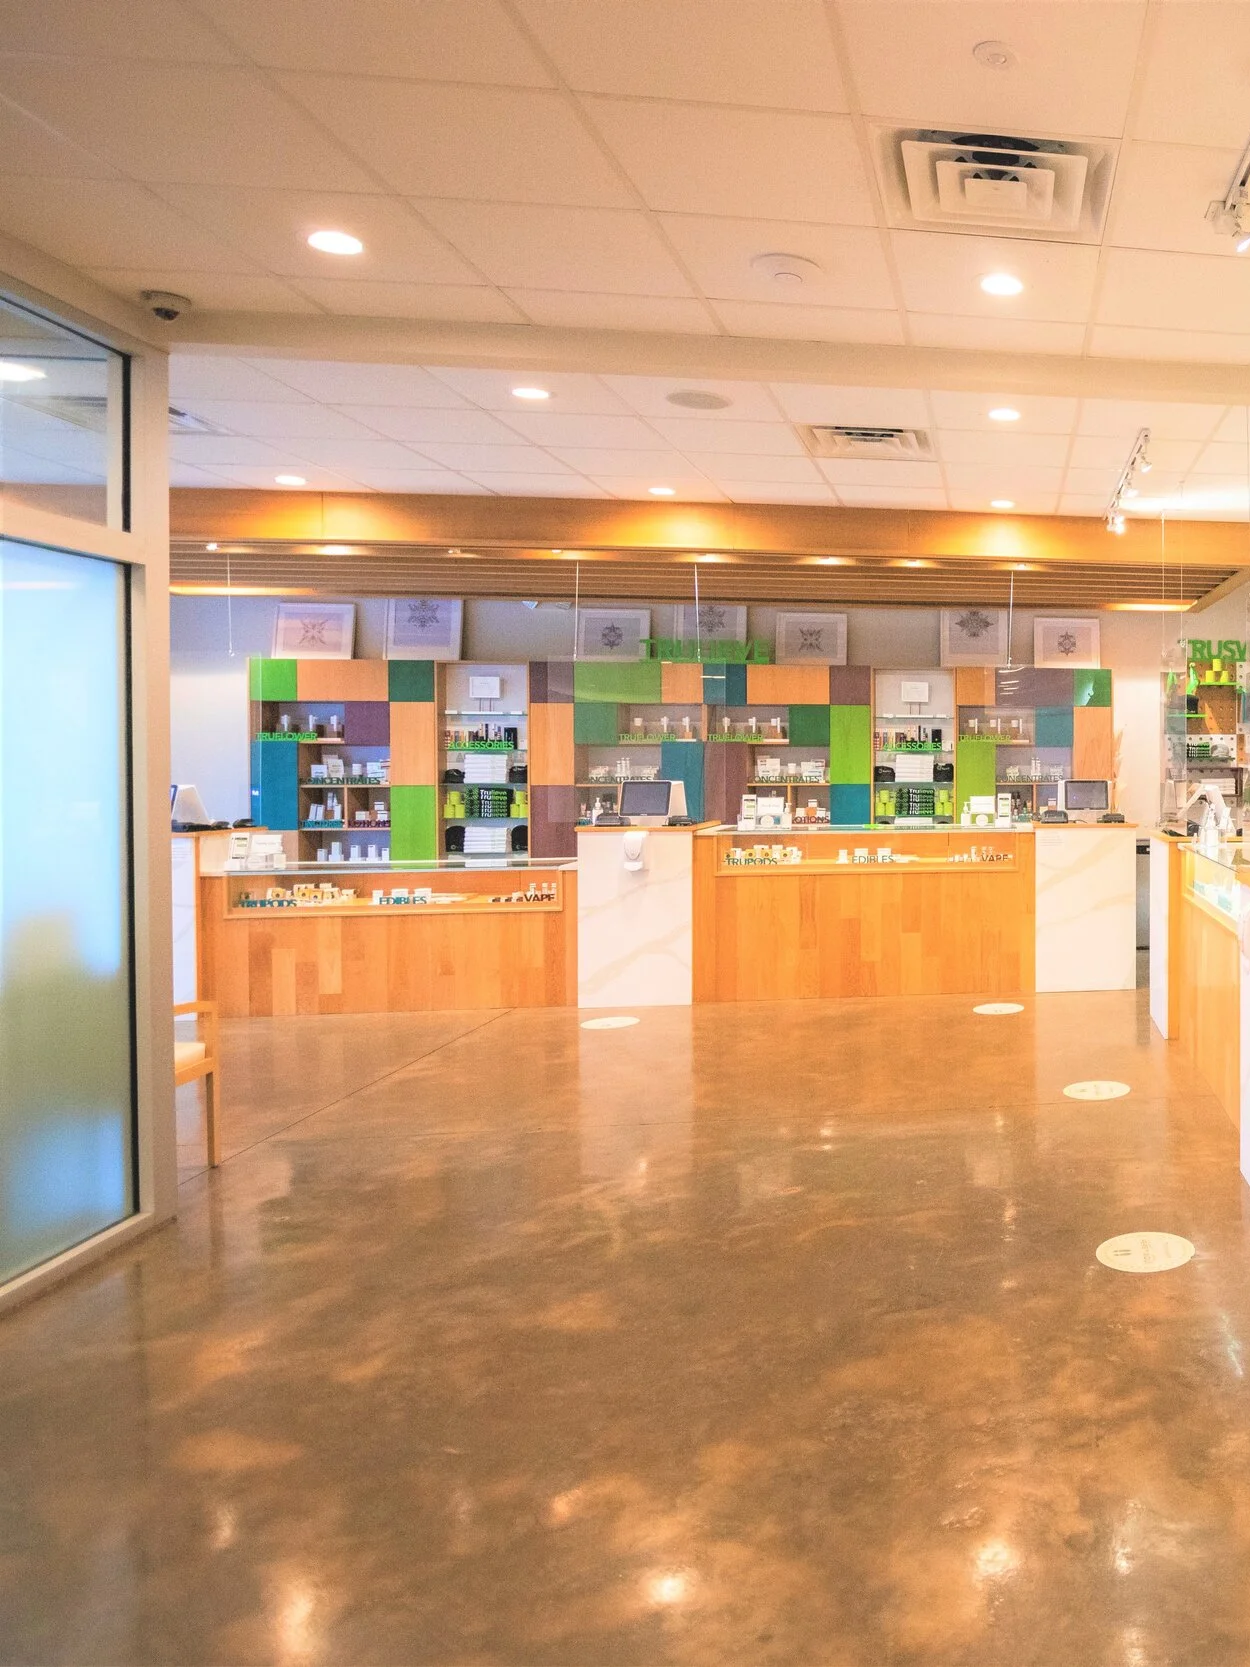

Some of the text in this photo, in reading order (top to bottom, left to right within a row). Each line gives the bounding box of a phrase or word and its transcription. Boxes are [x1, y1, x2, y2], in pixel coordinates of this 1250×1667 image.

[256, 732, 318, 741] TRUFLOWER
[619, 733, 676, 743] TRUFLOWER
[708, 733, 763, 743] TRUFLOWER
[448, 741, 514, 751] ACCESSORIES
[883, 742, 942, 752] ACCESSORIES
[726, 857, 778, 866] TRUPODS
[851, 855, 894, 864] EDIBLES
[379, 896, 427, 905] EDIBLES
